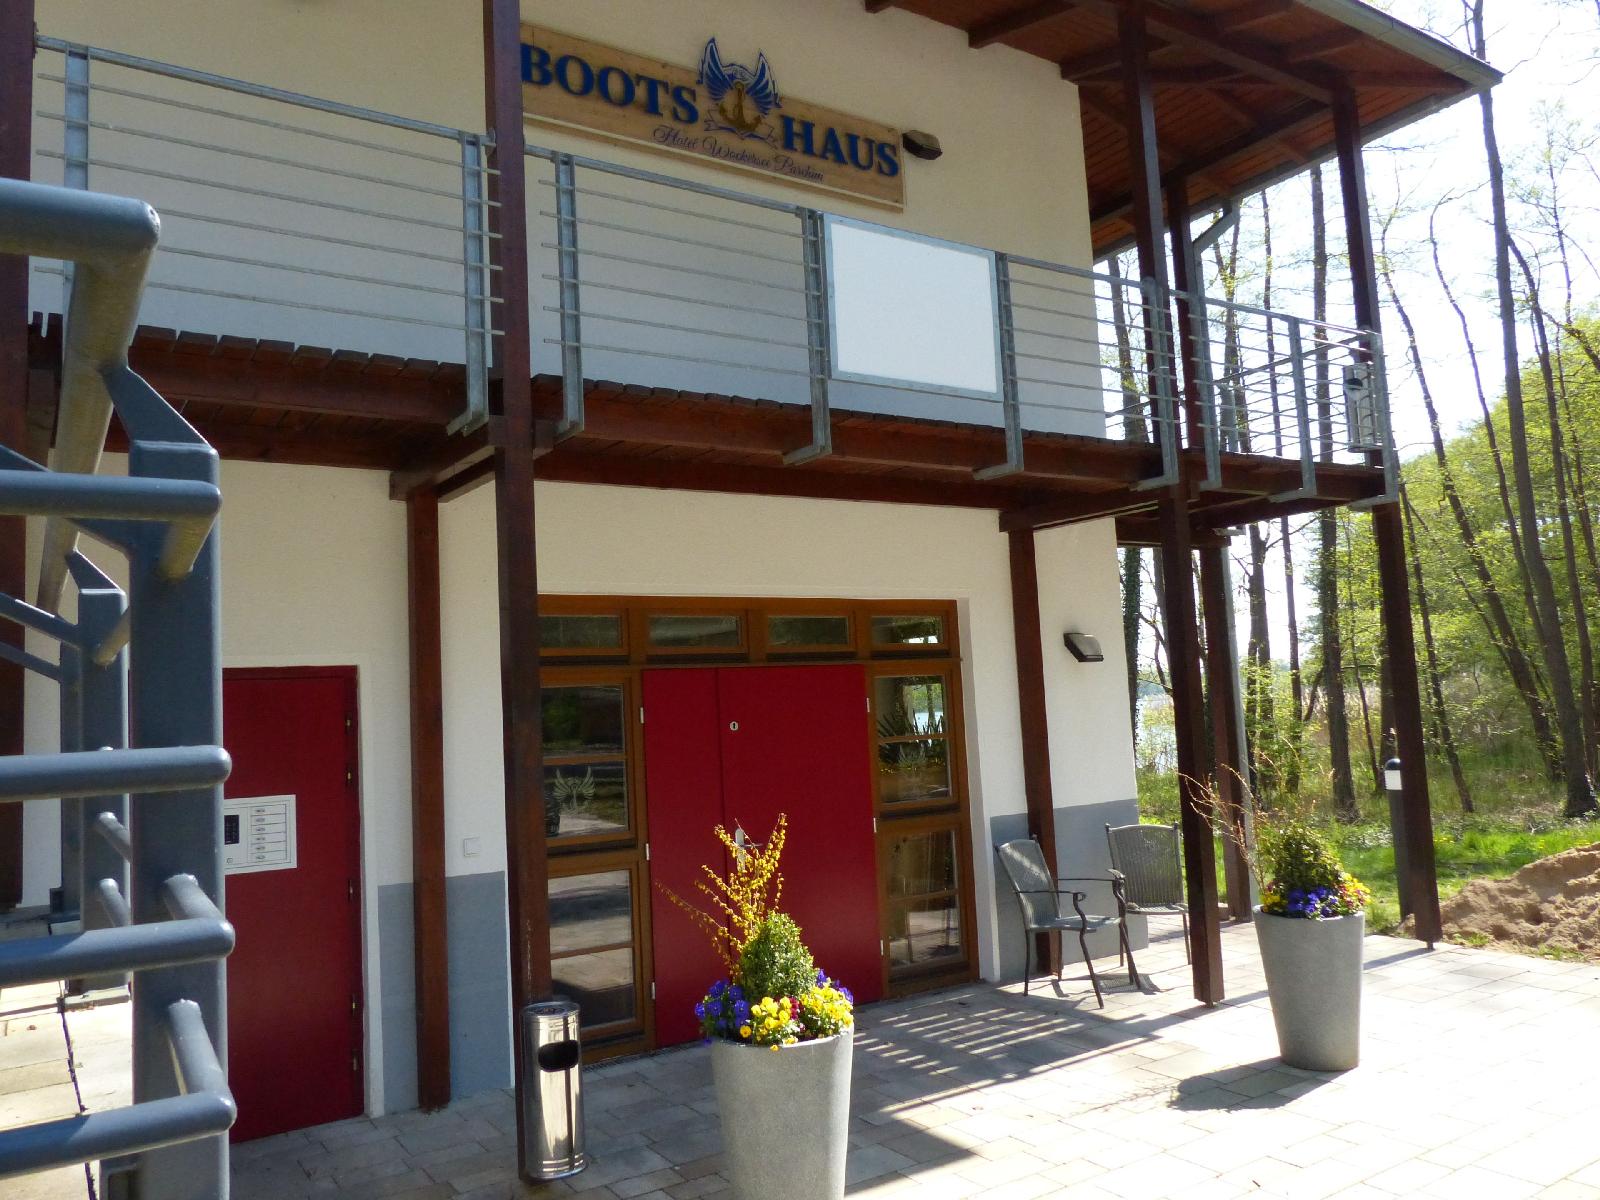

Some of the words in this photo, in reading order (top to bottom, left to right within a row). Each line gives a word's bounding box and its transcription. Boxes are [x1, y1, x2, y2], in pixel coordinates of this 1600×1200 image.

[520, 43, 699, 125] BOOTS
[780, 114, 898, 177] HAUS
[653, 124, 698, 149] Hotel
